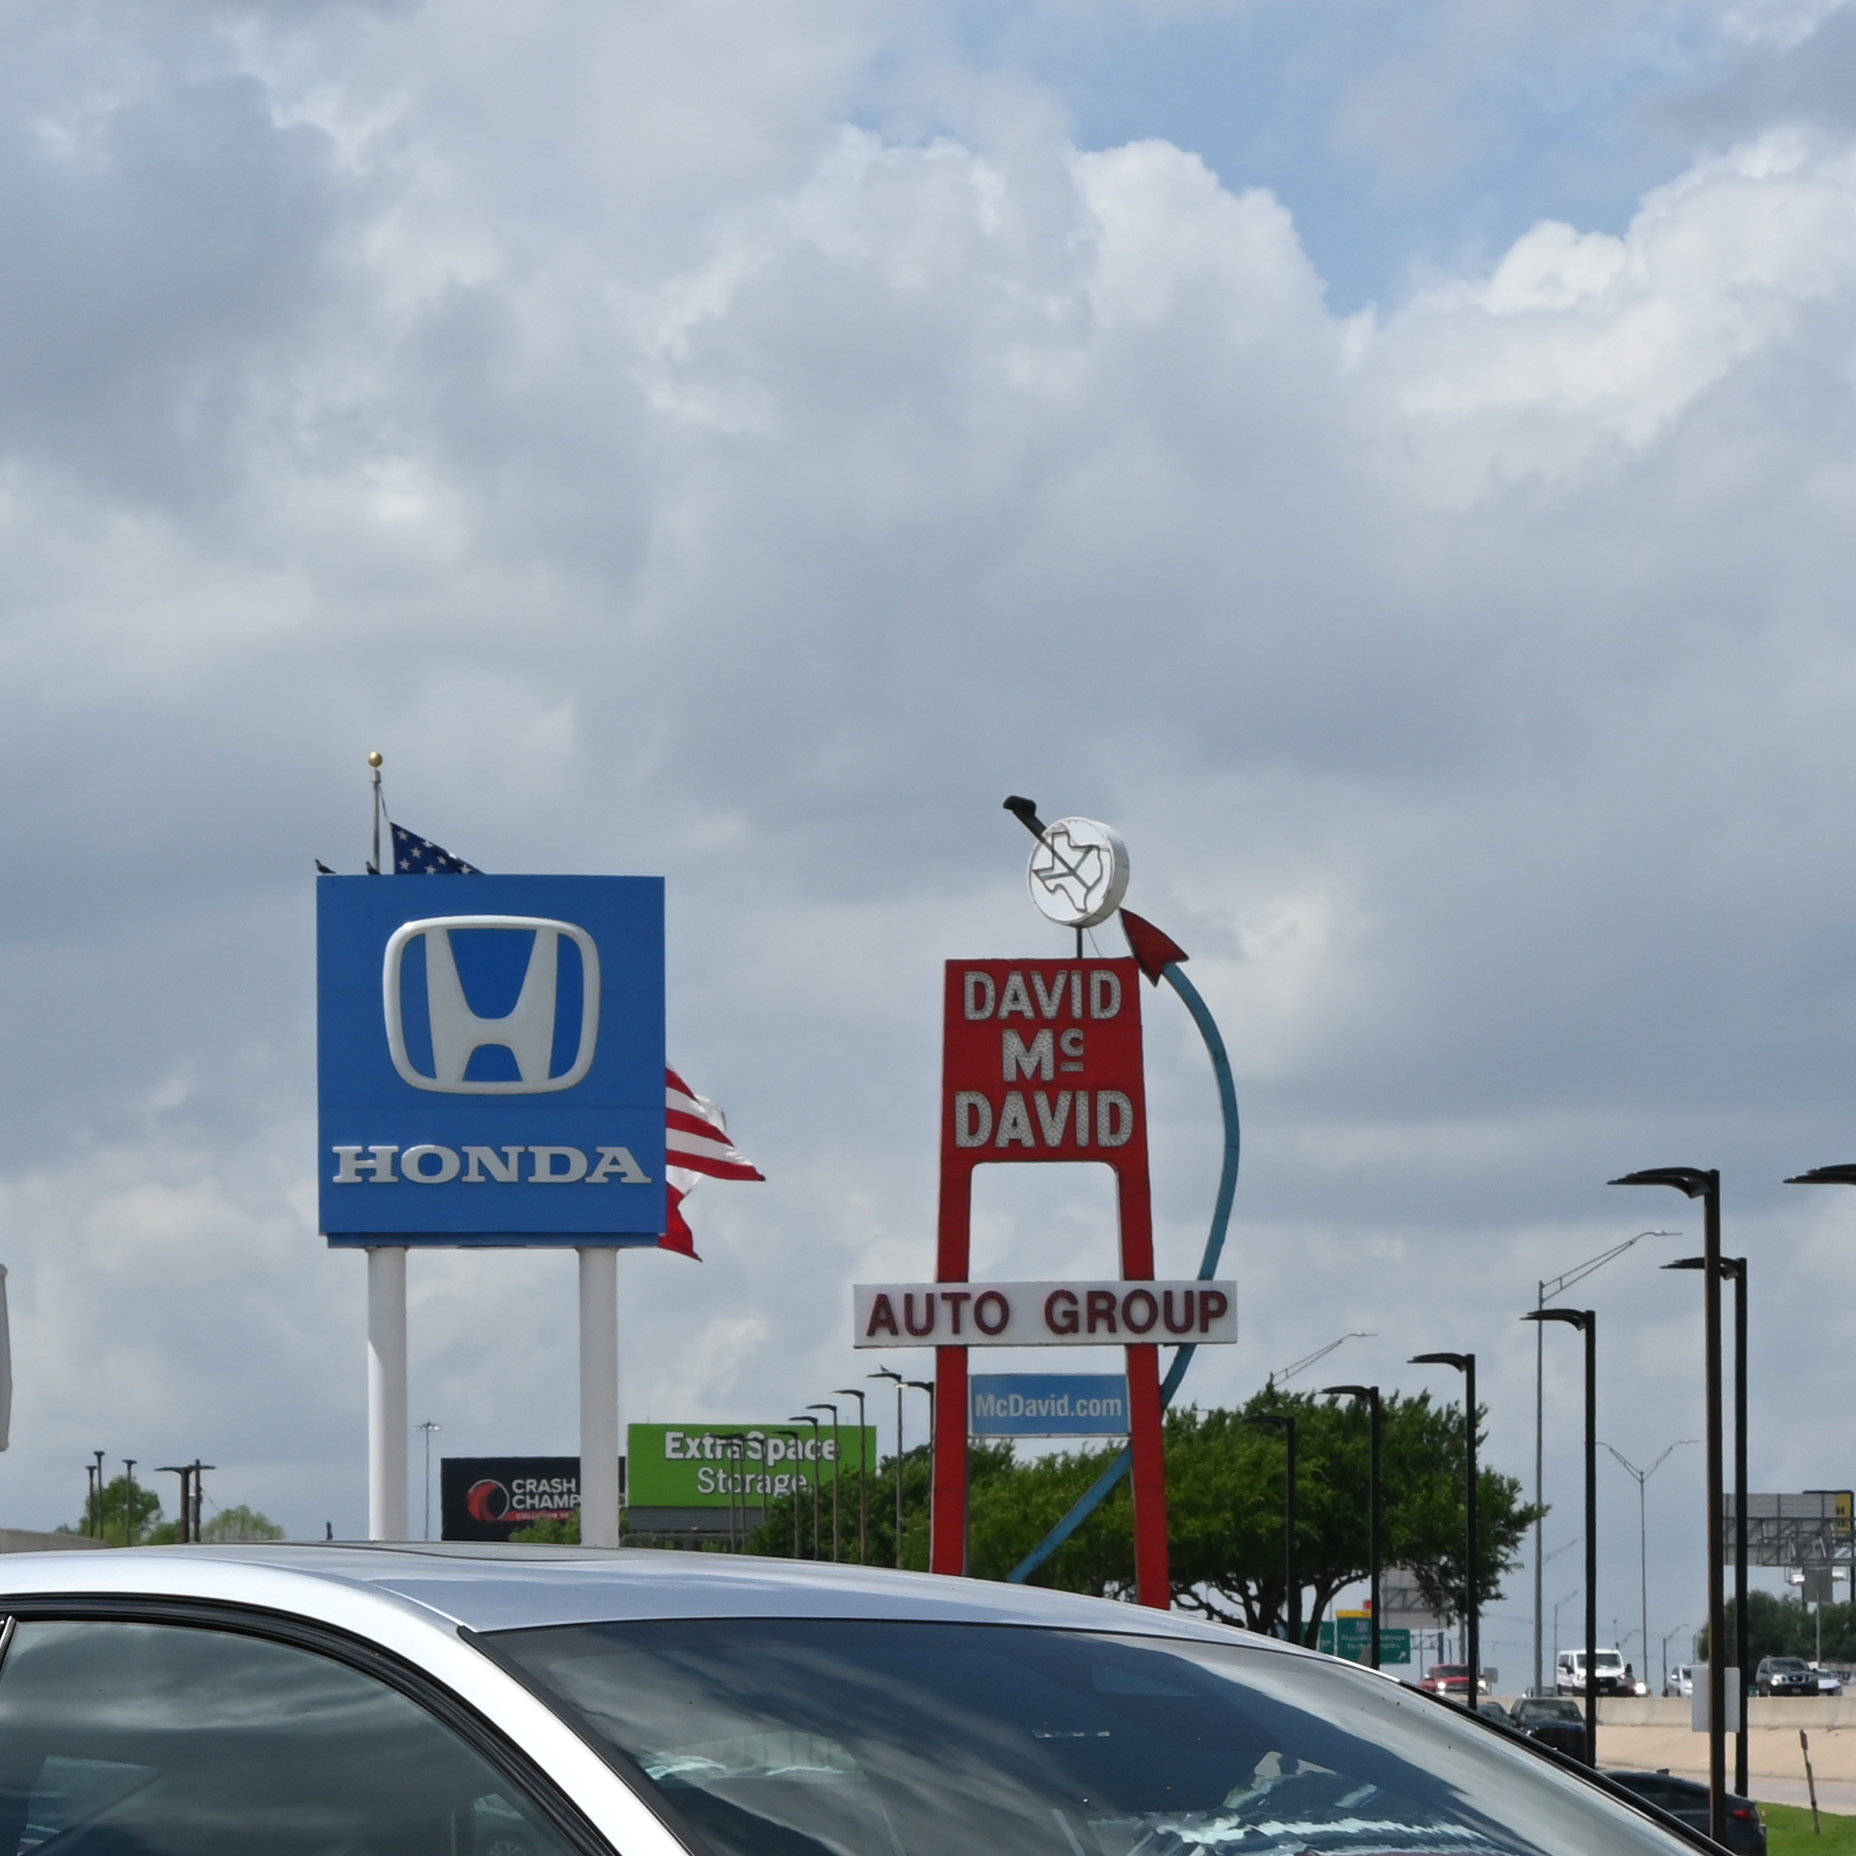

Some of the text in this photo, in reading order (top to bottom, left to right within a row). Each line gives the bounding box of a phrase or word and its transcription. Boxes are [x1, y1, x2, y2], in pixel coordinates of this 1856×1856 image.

[964, 970, 1122, 1020] DAVID
[954, 1090, 1134, 1148] DAVID
[332, 1144, 652, 1184] HONDA
[866, 1289, 1228, 1337] AUTO GROUP
[975, 1394, 1122, 1418] McDavid.com
[512, 1478, 576, 1494] CRASH
[697, 1467, 807, 1498] Storage
